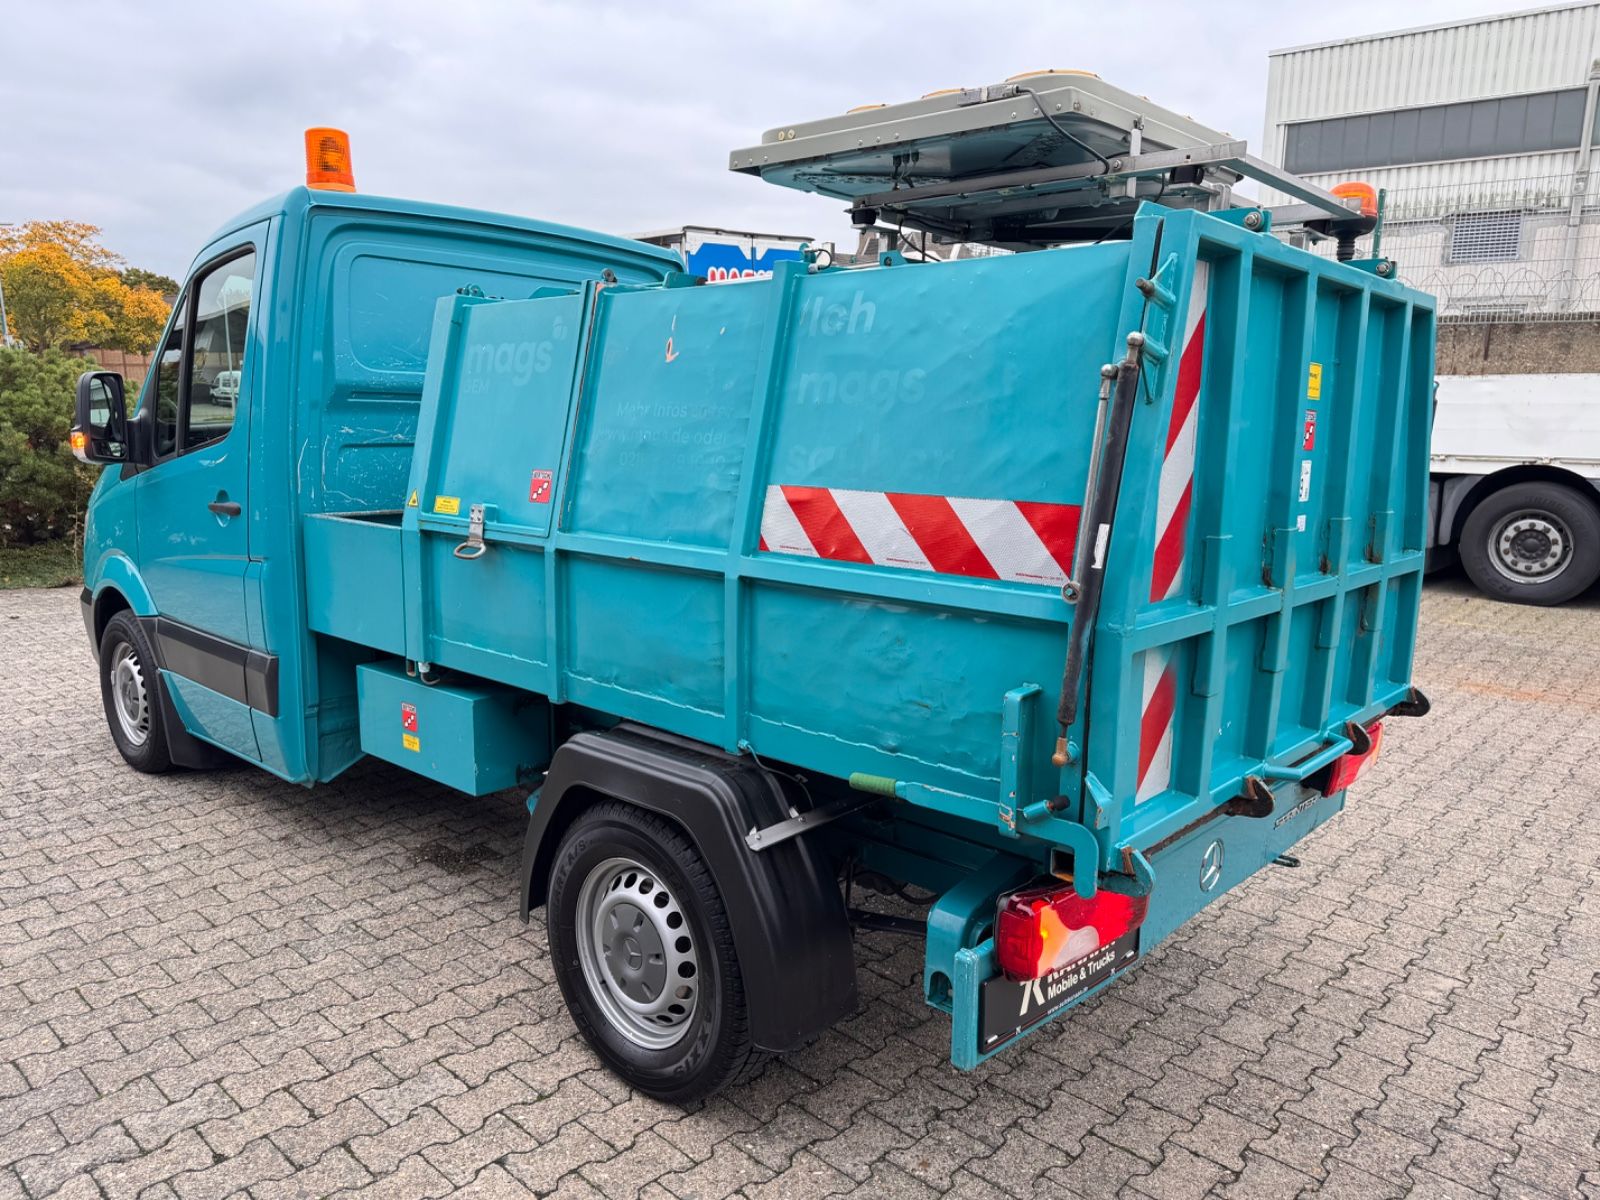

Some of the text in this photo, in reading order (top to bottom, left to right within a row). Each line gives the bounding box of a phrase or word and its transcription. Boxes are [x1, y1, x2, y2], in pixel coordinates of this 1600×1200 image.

[807, 290, 877, 337] Ich
[465, 340, 554, 387] mags
[796, 367, 927, 416] mags
[1047, 974, 1078, 1000] Mobile
[1079, 968, 1087, 983] &
[1087, 950, 1116, 975] Trucks
